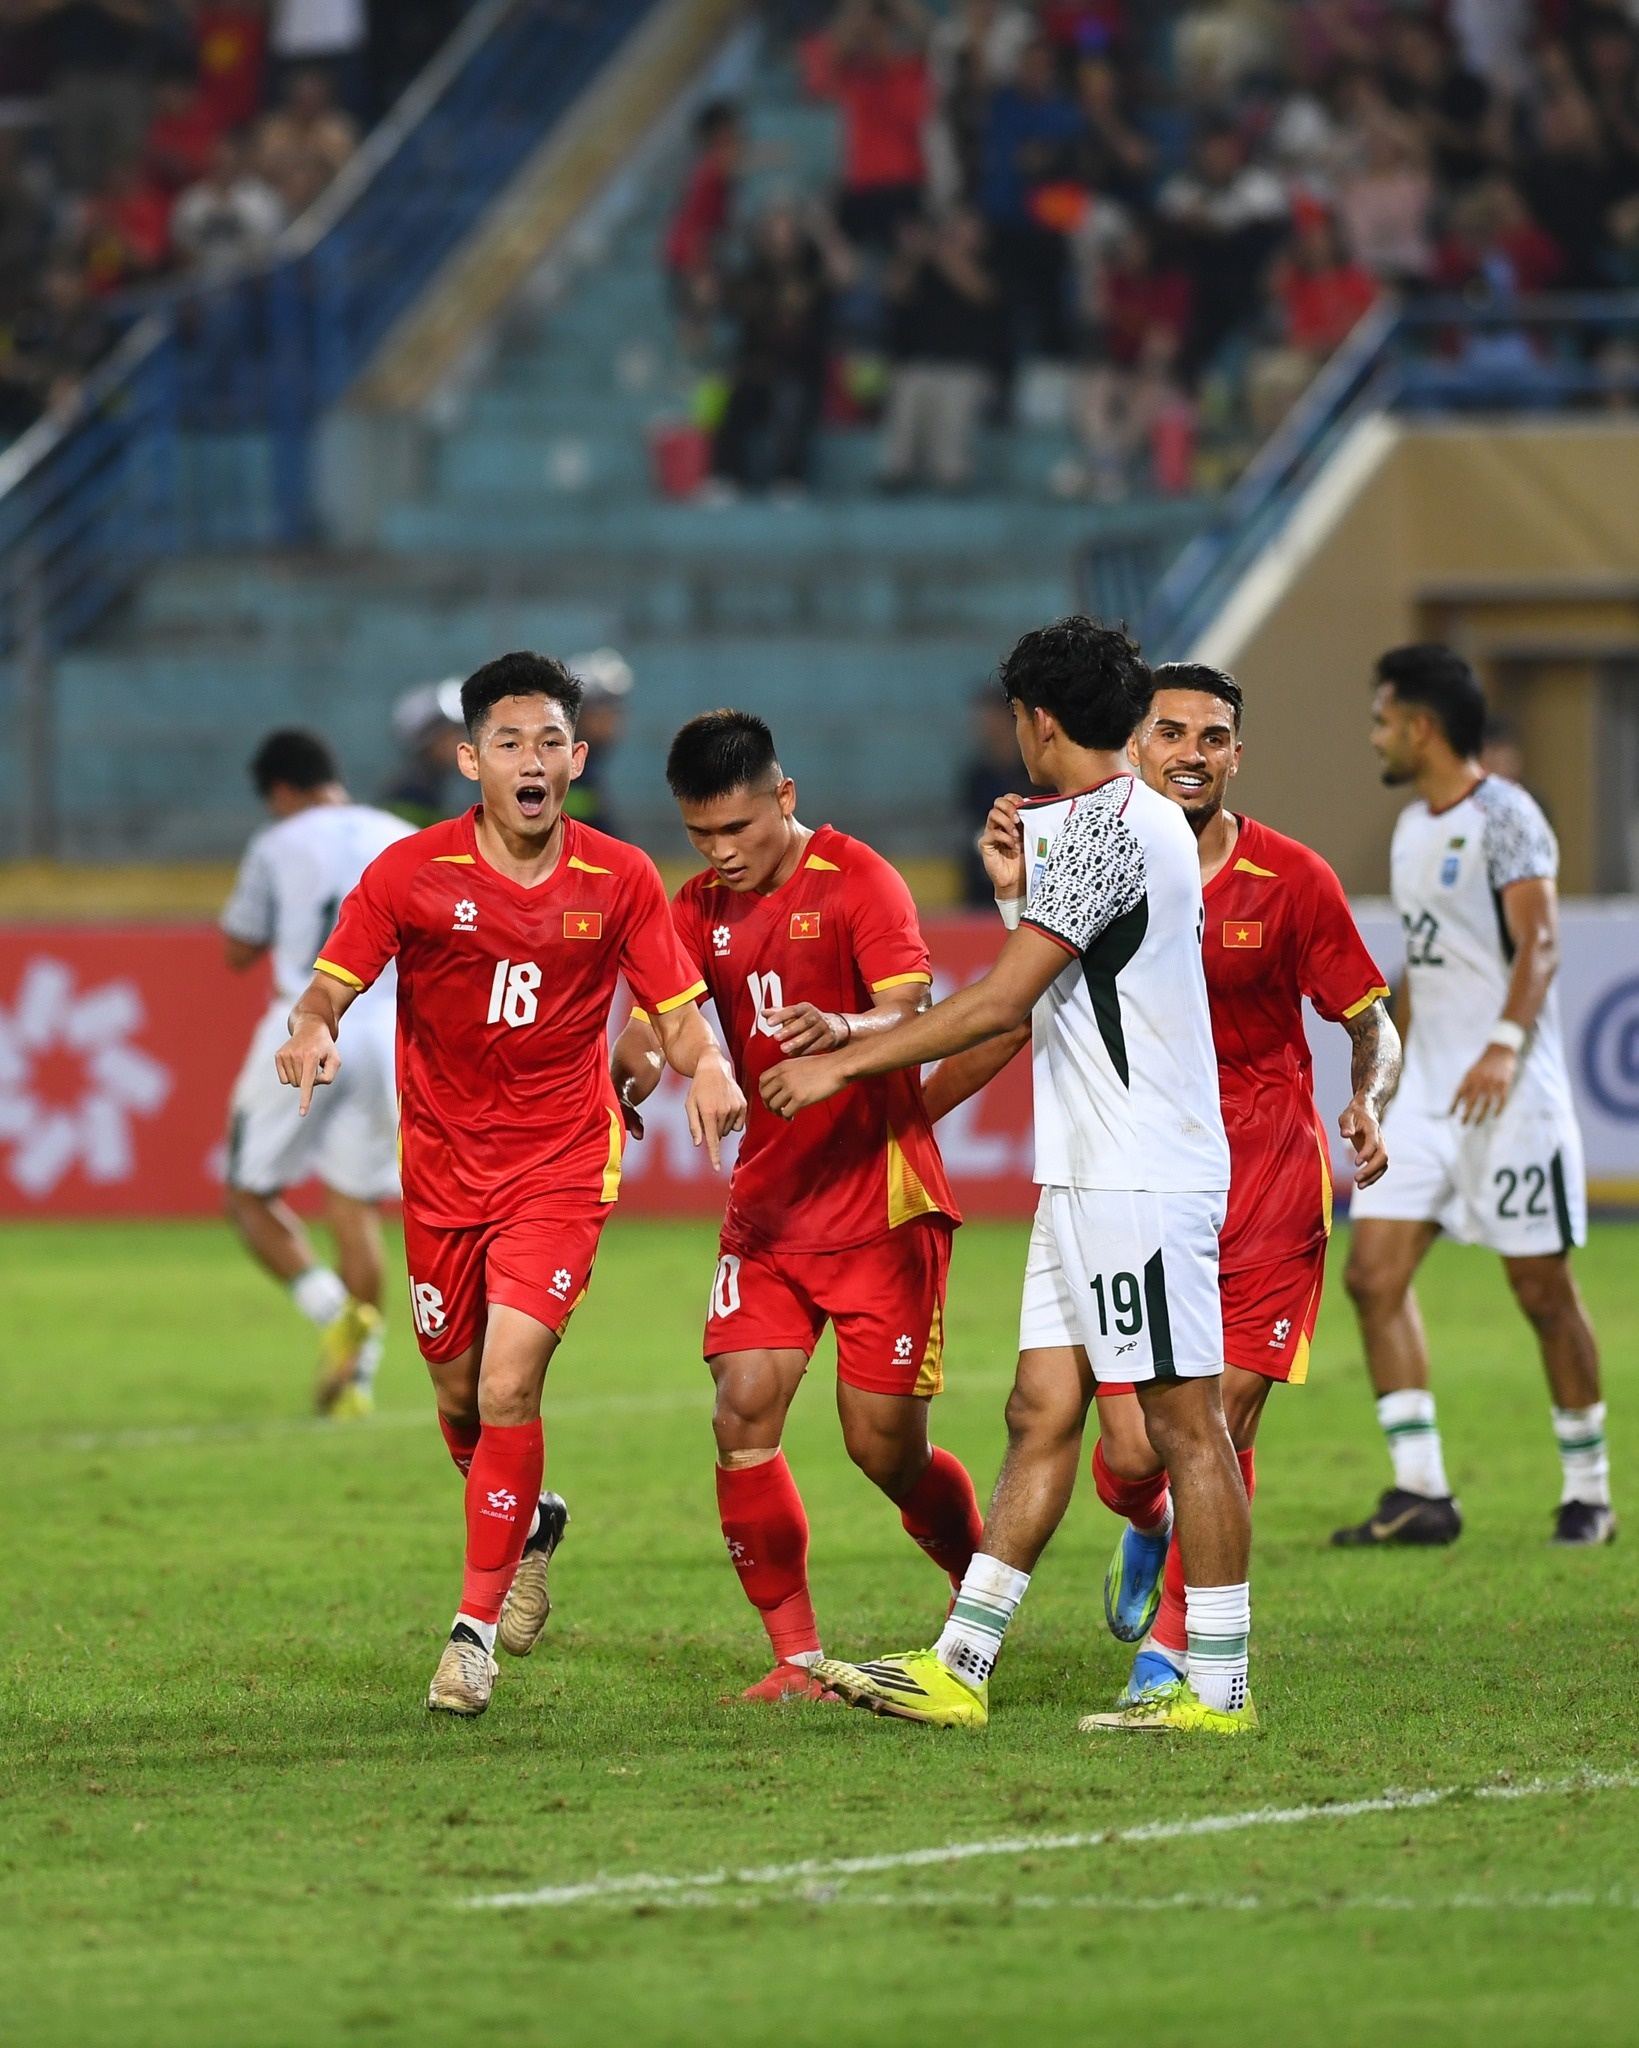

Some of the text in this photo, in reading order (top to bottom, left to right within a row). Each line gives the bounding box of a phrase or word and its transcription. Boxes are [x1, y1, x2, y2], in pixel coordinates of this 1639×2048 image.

[487, 958, 543, 1028] 18
[746, 969, 784, 1039] 10
[1494, 1166, 1548, 1218] 22
[409, 1275, 449, 1339] 18
[1089, 1271, 1143, 1336] 19
